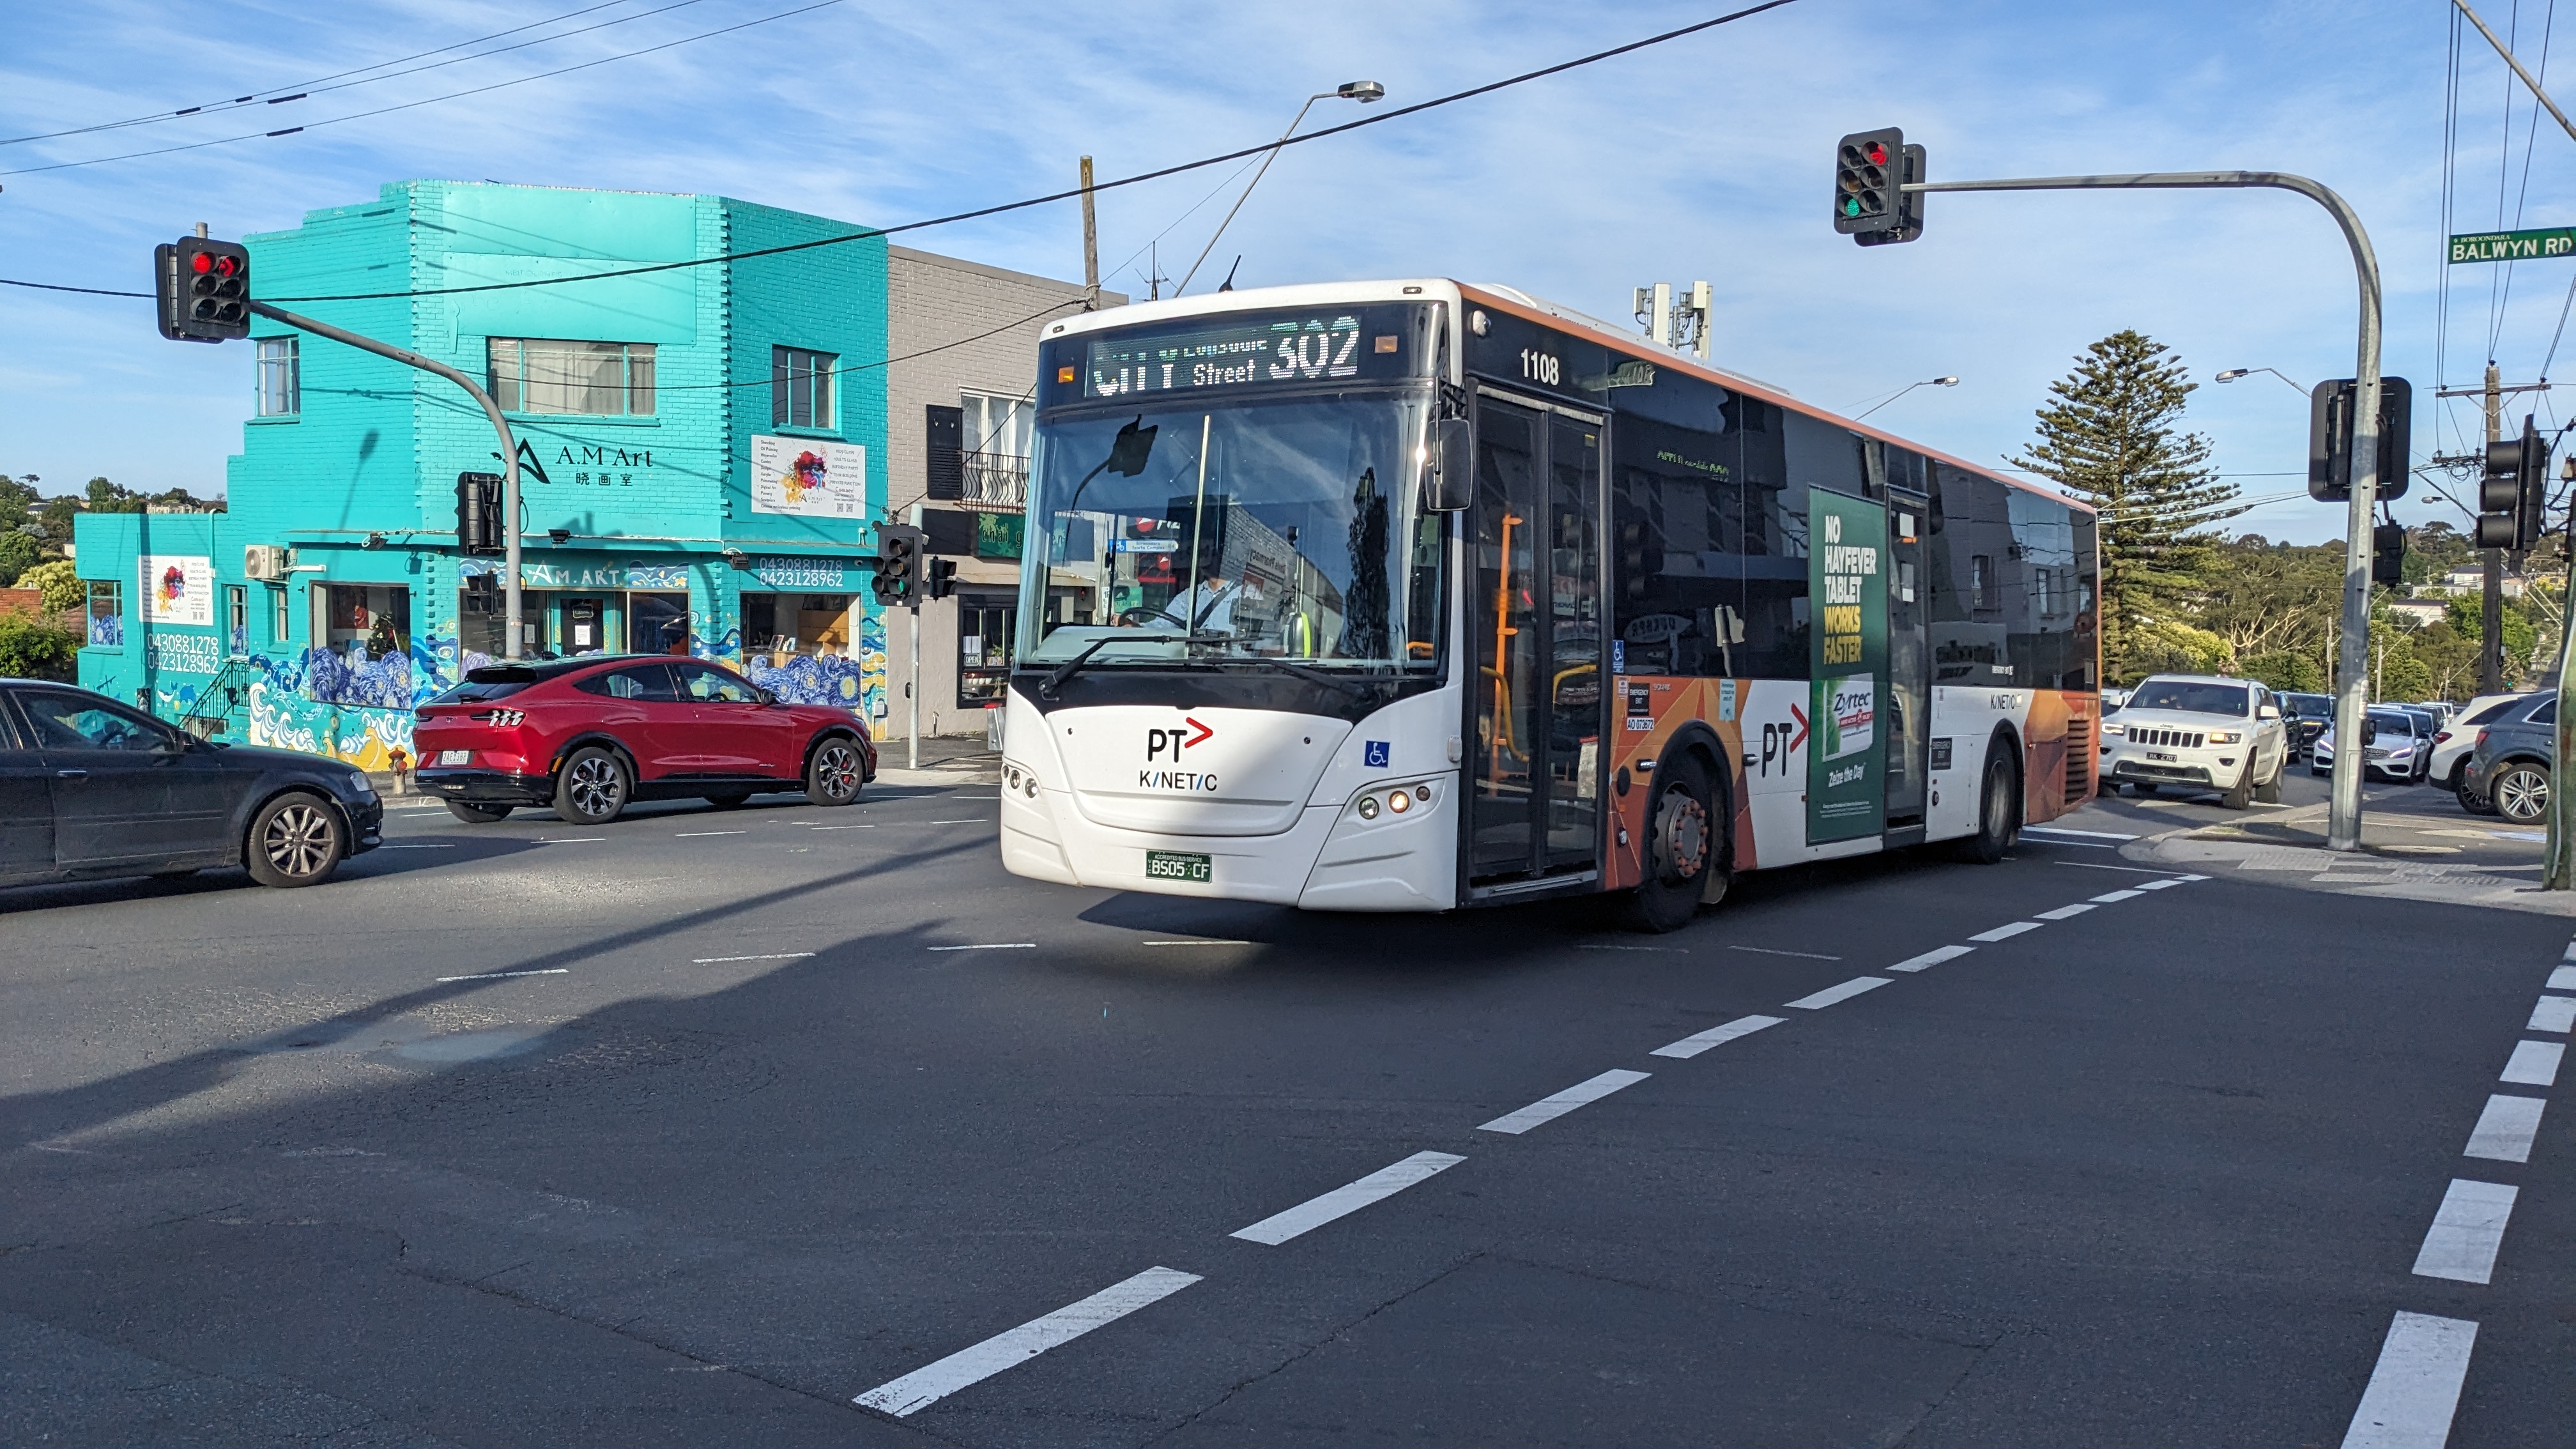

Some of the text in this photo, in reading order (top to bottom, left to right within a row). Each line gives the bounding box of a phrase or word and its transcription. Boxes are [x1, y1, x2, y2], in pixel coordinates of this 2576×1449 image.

[2452, 238, 2573, 261] BALWYN RD
[2460, 234, 2510, 243] BOROONDARA
[1269, 316, 1360, 378] 302
[1193, 359, 1255, 386] Street
[1521, 348, 1560, 386] 1108
[555, 445, 654, 468] A.M Art
[576, 471, 633, 487] 晓画室
[981, 524, 1009, 543] chai
[1825, 515, 1841, 544] NO
[759, 557, 843, 572] 0430881278
[1825, 546, 1877, 574] HAYFEVER
[760, 572, 843, 587] 0423128962
[1824, 576, 1862, 604] TABLET
[1824, 606, 1860, 634] WORKS
[147, 632, 219, 656] 0430881278
[1823, 636, 1862, 664] FASTER
[148, 652, 219, 674] 0423128962
[1834, 692, 1872, 716] Zyrtec
[1844, 767, 1853, 783] the
[1151, 859, 1210, 878] BS05 CF
